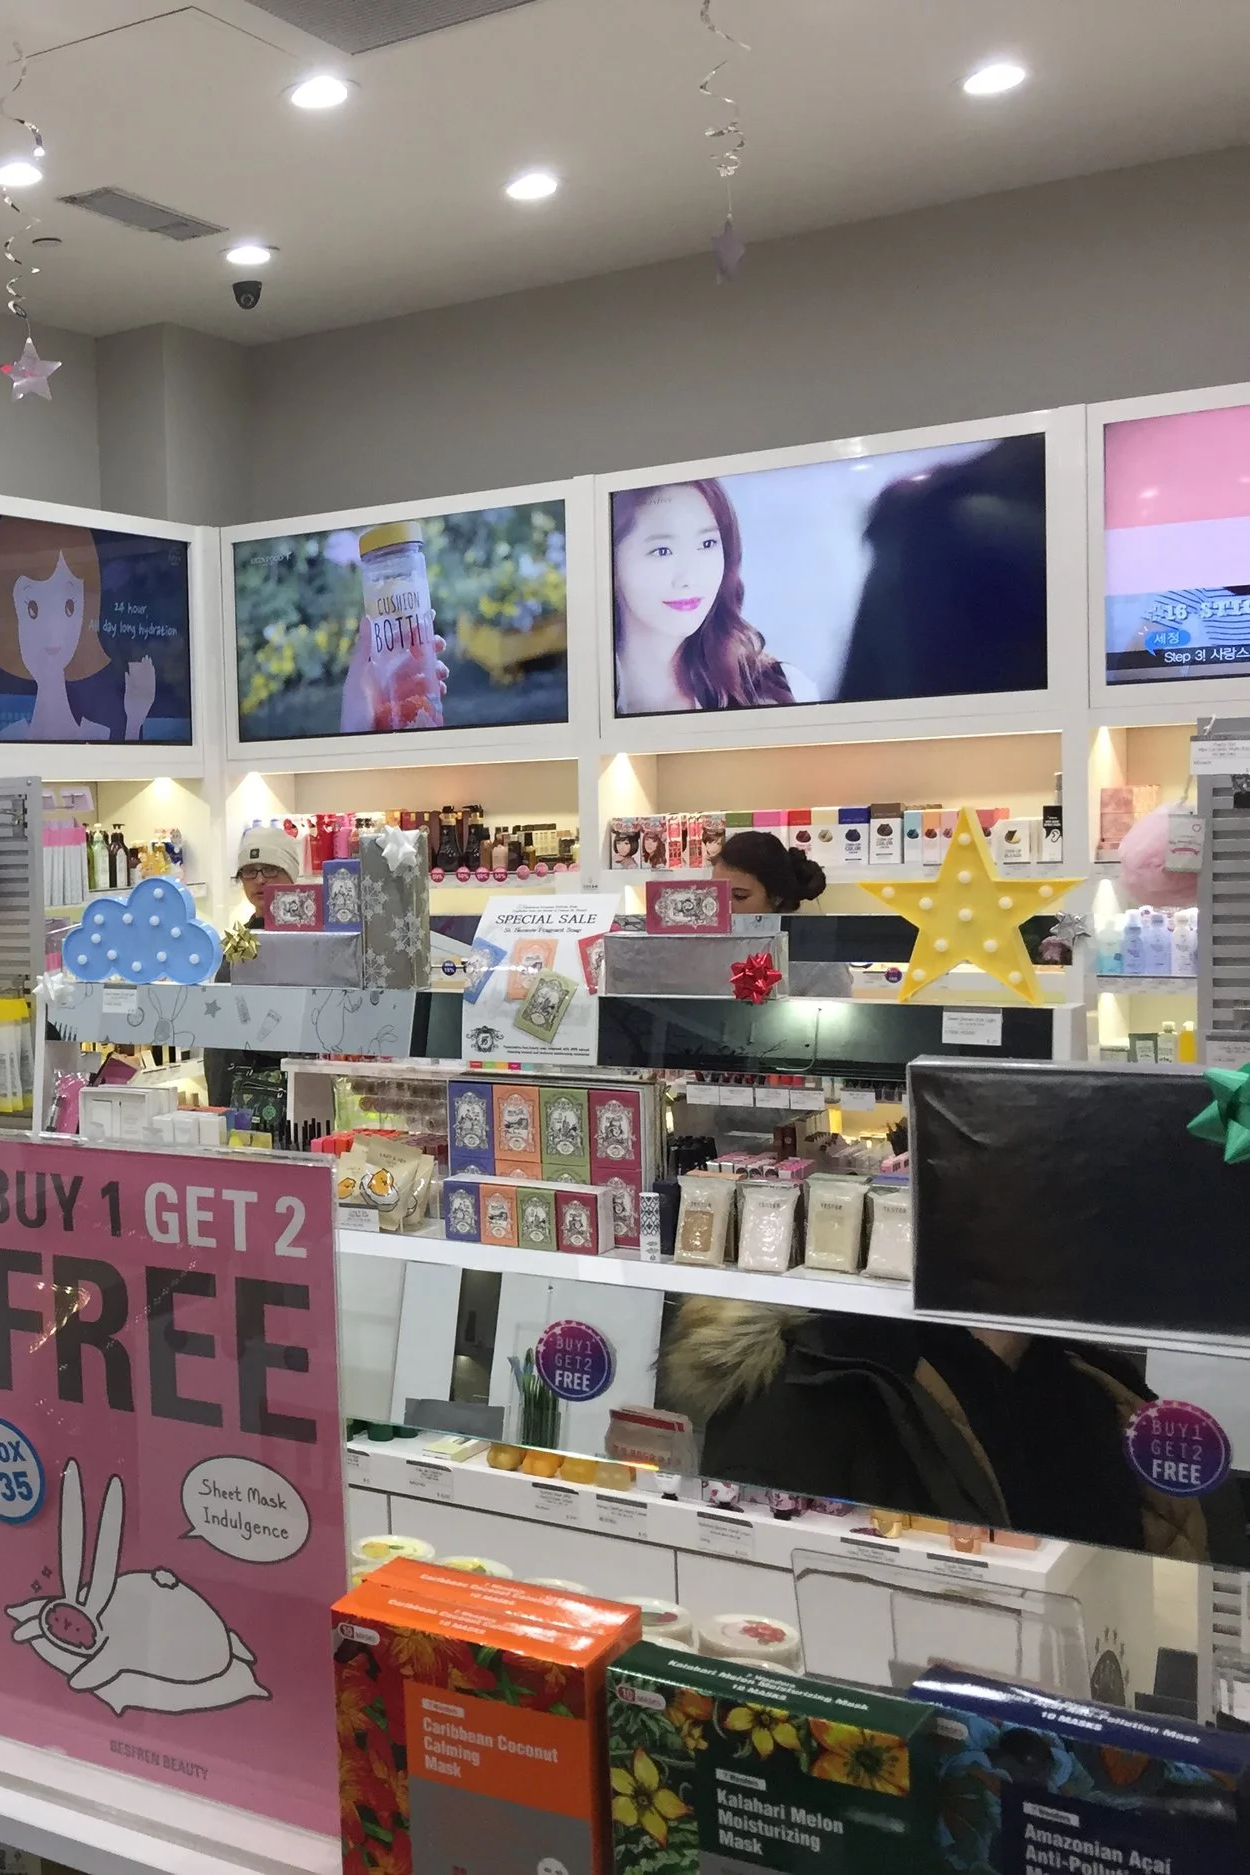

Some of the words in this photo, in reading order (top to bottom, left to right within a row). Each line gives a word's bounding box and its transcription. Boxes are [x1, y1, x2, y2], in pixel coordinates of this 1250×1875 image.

[114, 601, 125, 613] 24
[377, 591, 421, 616] CUSHION
[103, 619, 117, 638] day
[120, 621, 136, 640] long
[138, 622, 178, 640] hydration
[1153, 631, 1180, 645] 세정
[1164, 651, 1191, 663] Step
[495, 914, 554, 925] SPECIAL
[558, 913, 597, 925] SALE
[100, 1181, 121, 1237] 1
[144, 1182, 258, 1252] GET
[274, 1196, 308, 1258] 2
[554, 1369, 591, 1392] FREE
[1152, 1459, 1202, 1485] FREE
[198, 1478, 242, 1502] Sheet
[247, 1487, 287, 1510] Mask
[203, 1506, 289, 1540] Indulgence
[620, 1687, 632, 1699] 10
[667, 1659, 717, 1677] Kalahari
[718, 1670, 756, 1686] Melon
[757, 1680, 832, 1703] Moisturizing
[835, 1696, 869, 1711] Mask
[747, 1686, 788, 1701] MASKS
[1041, 1711, 1056, 1720] 10
[1058, 1714, 1103, 1731] MASKS
[423, 1716, 494, 1748] Caribbean
[498, 1735, 559, 1763] Coconut
[1162, 1727, 1200, 1744] Mask
[424, 1736, 480, 1766] Calming
[162, 1754, 209, 1780] BEAUTY
[424, 1754, 462, 1778] Mask
[717, 1788, 786, 1820] Kalahari
[790, 1806, 844, 1834] Melon
[718, 1809, 821, 1853] Moisturizing
[718, 1829, 763, 1856] Mask
[1024, 1823, 1123, 1864] Amazonian
